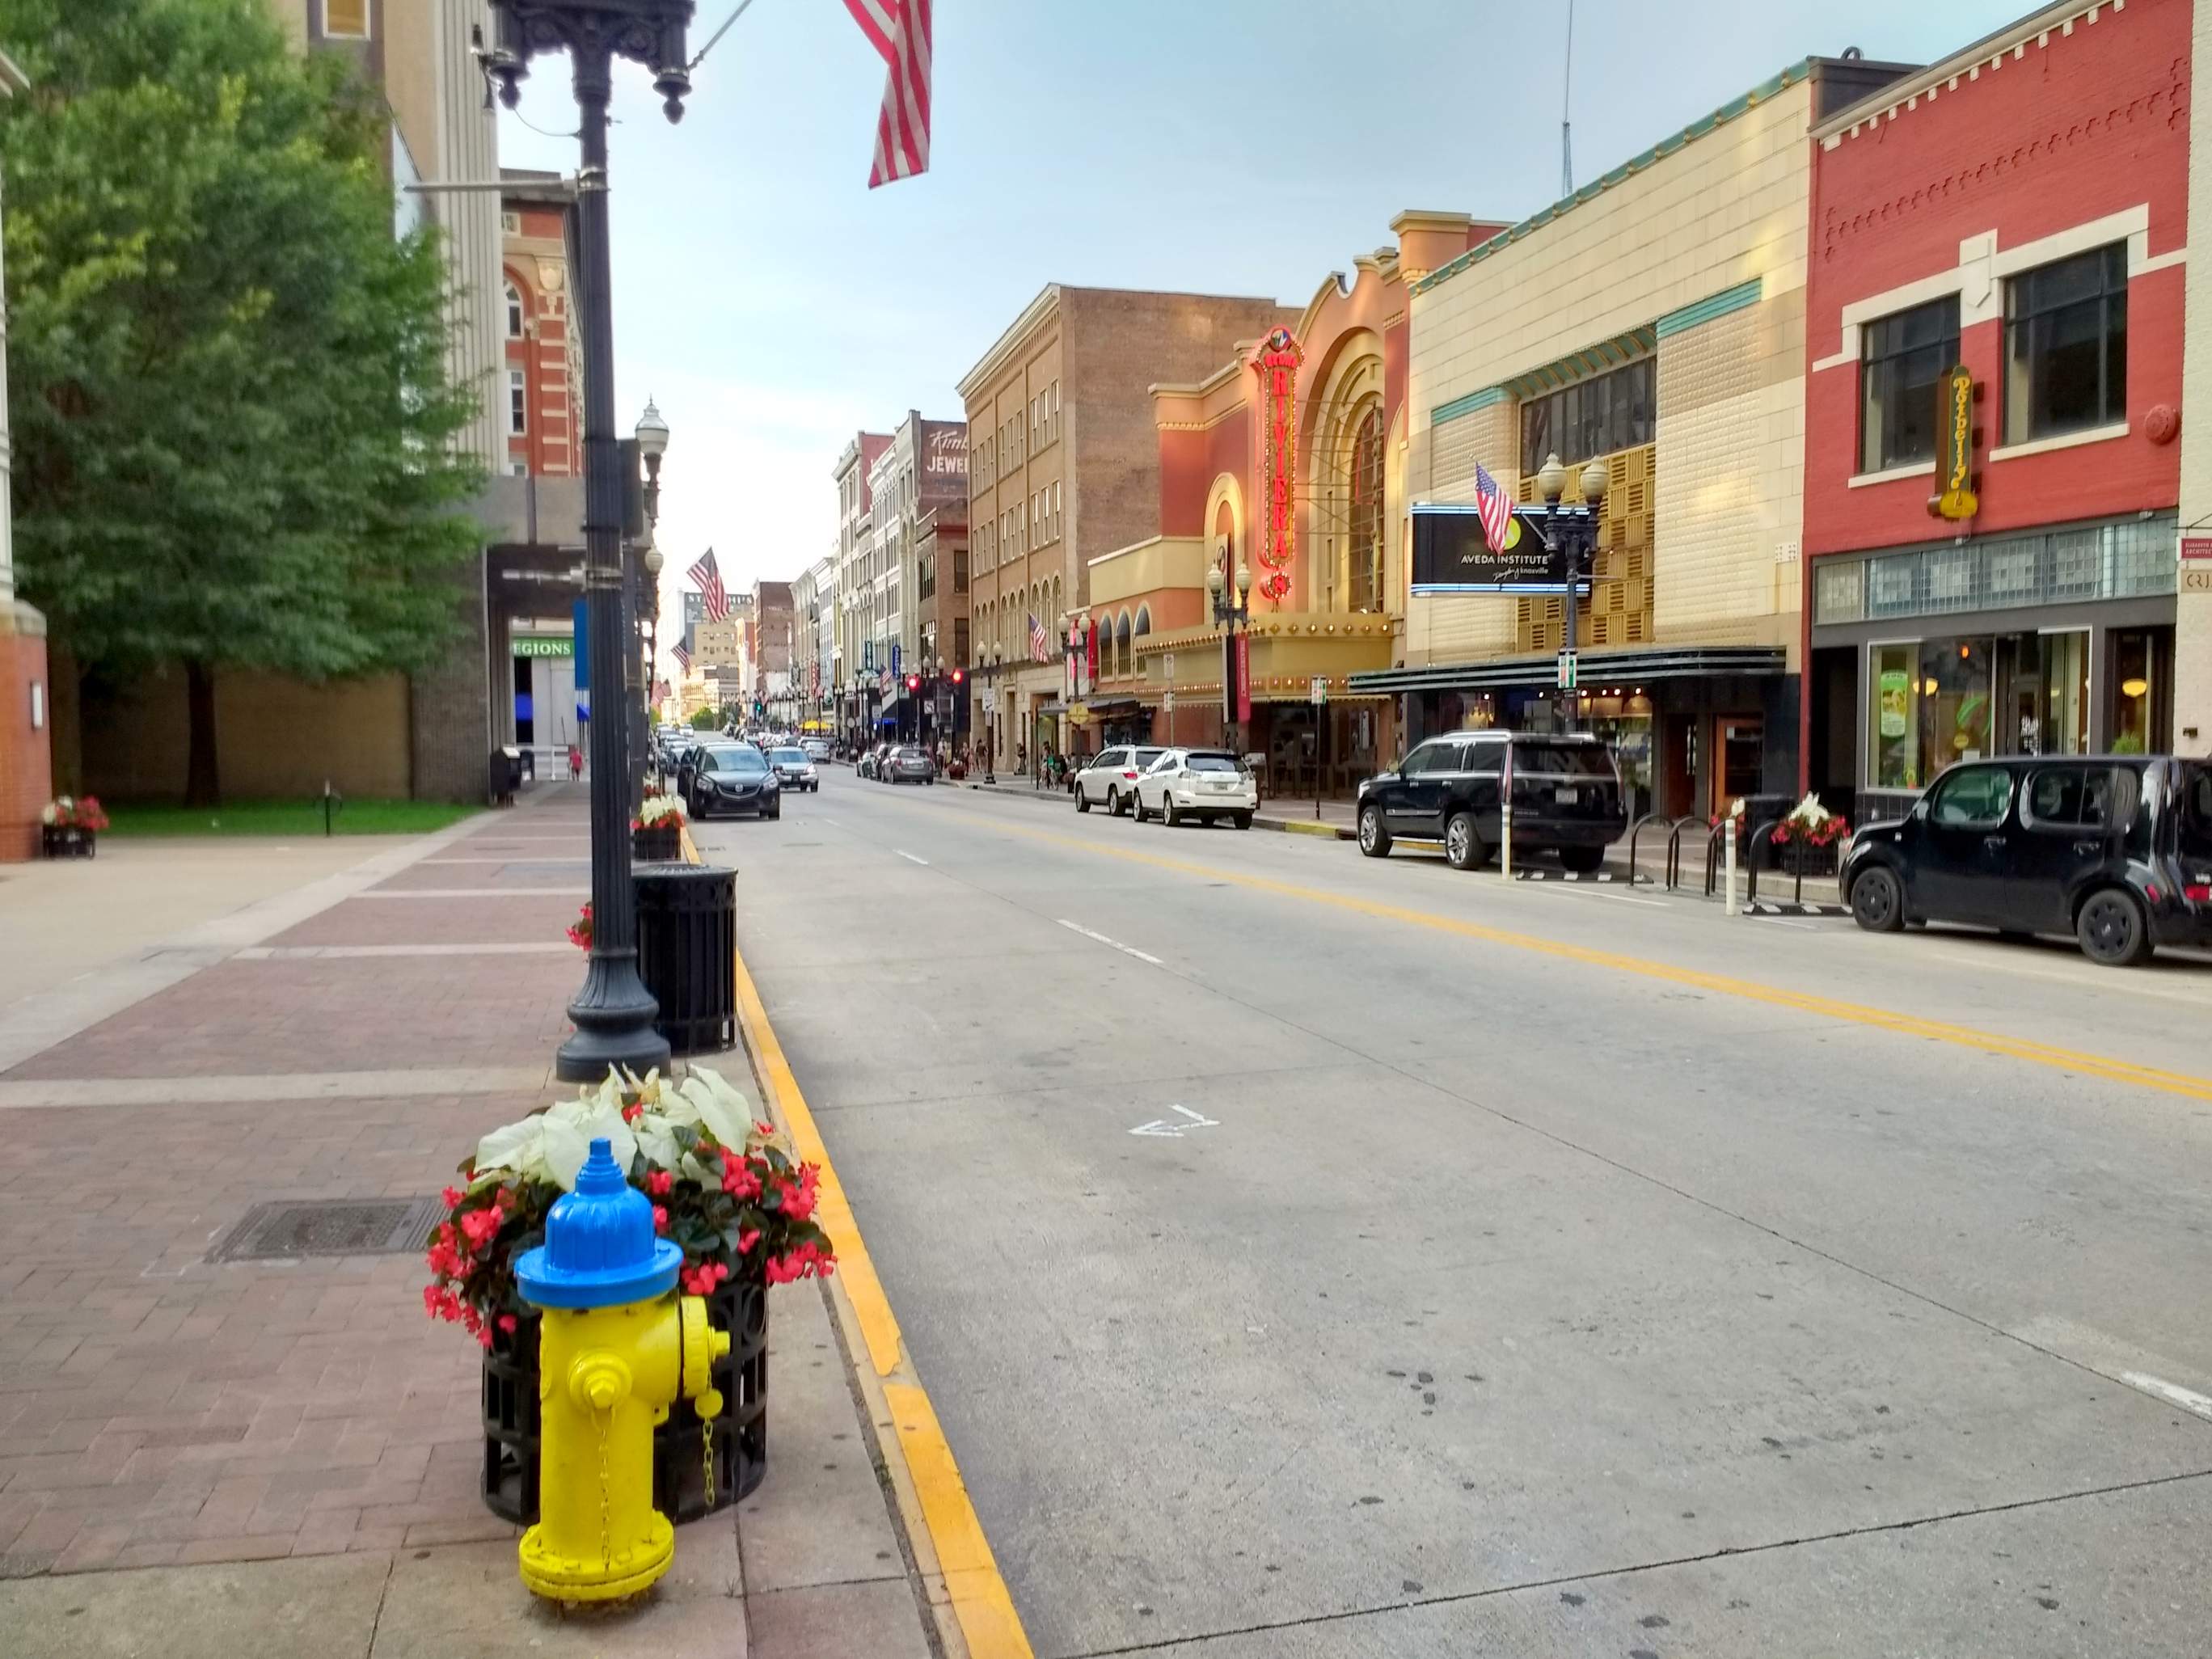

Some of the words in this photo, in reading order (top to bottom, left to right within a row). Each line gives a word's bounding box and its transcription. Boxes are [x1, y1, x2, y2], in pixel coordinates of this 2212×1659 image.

[1272, 369, 1289, 558] RIVIERA
[1951, 377, 1970, 489] Potbelly
[1461, 554, 1495, 564] AVEDA
[1497, 554, 1548, 564] INSTITUTE
[1520, 567, 1548, 575] knoxville
